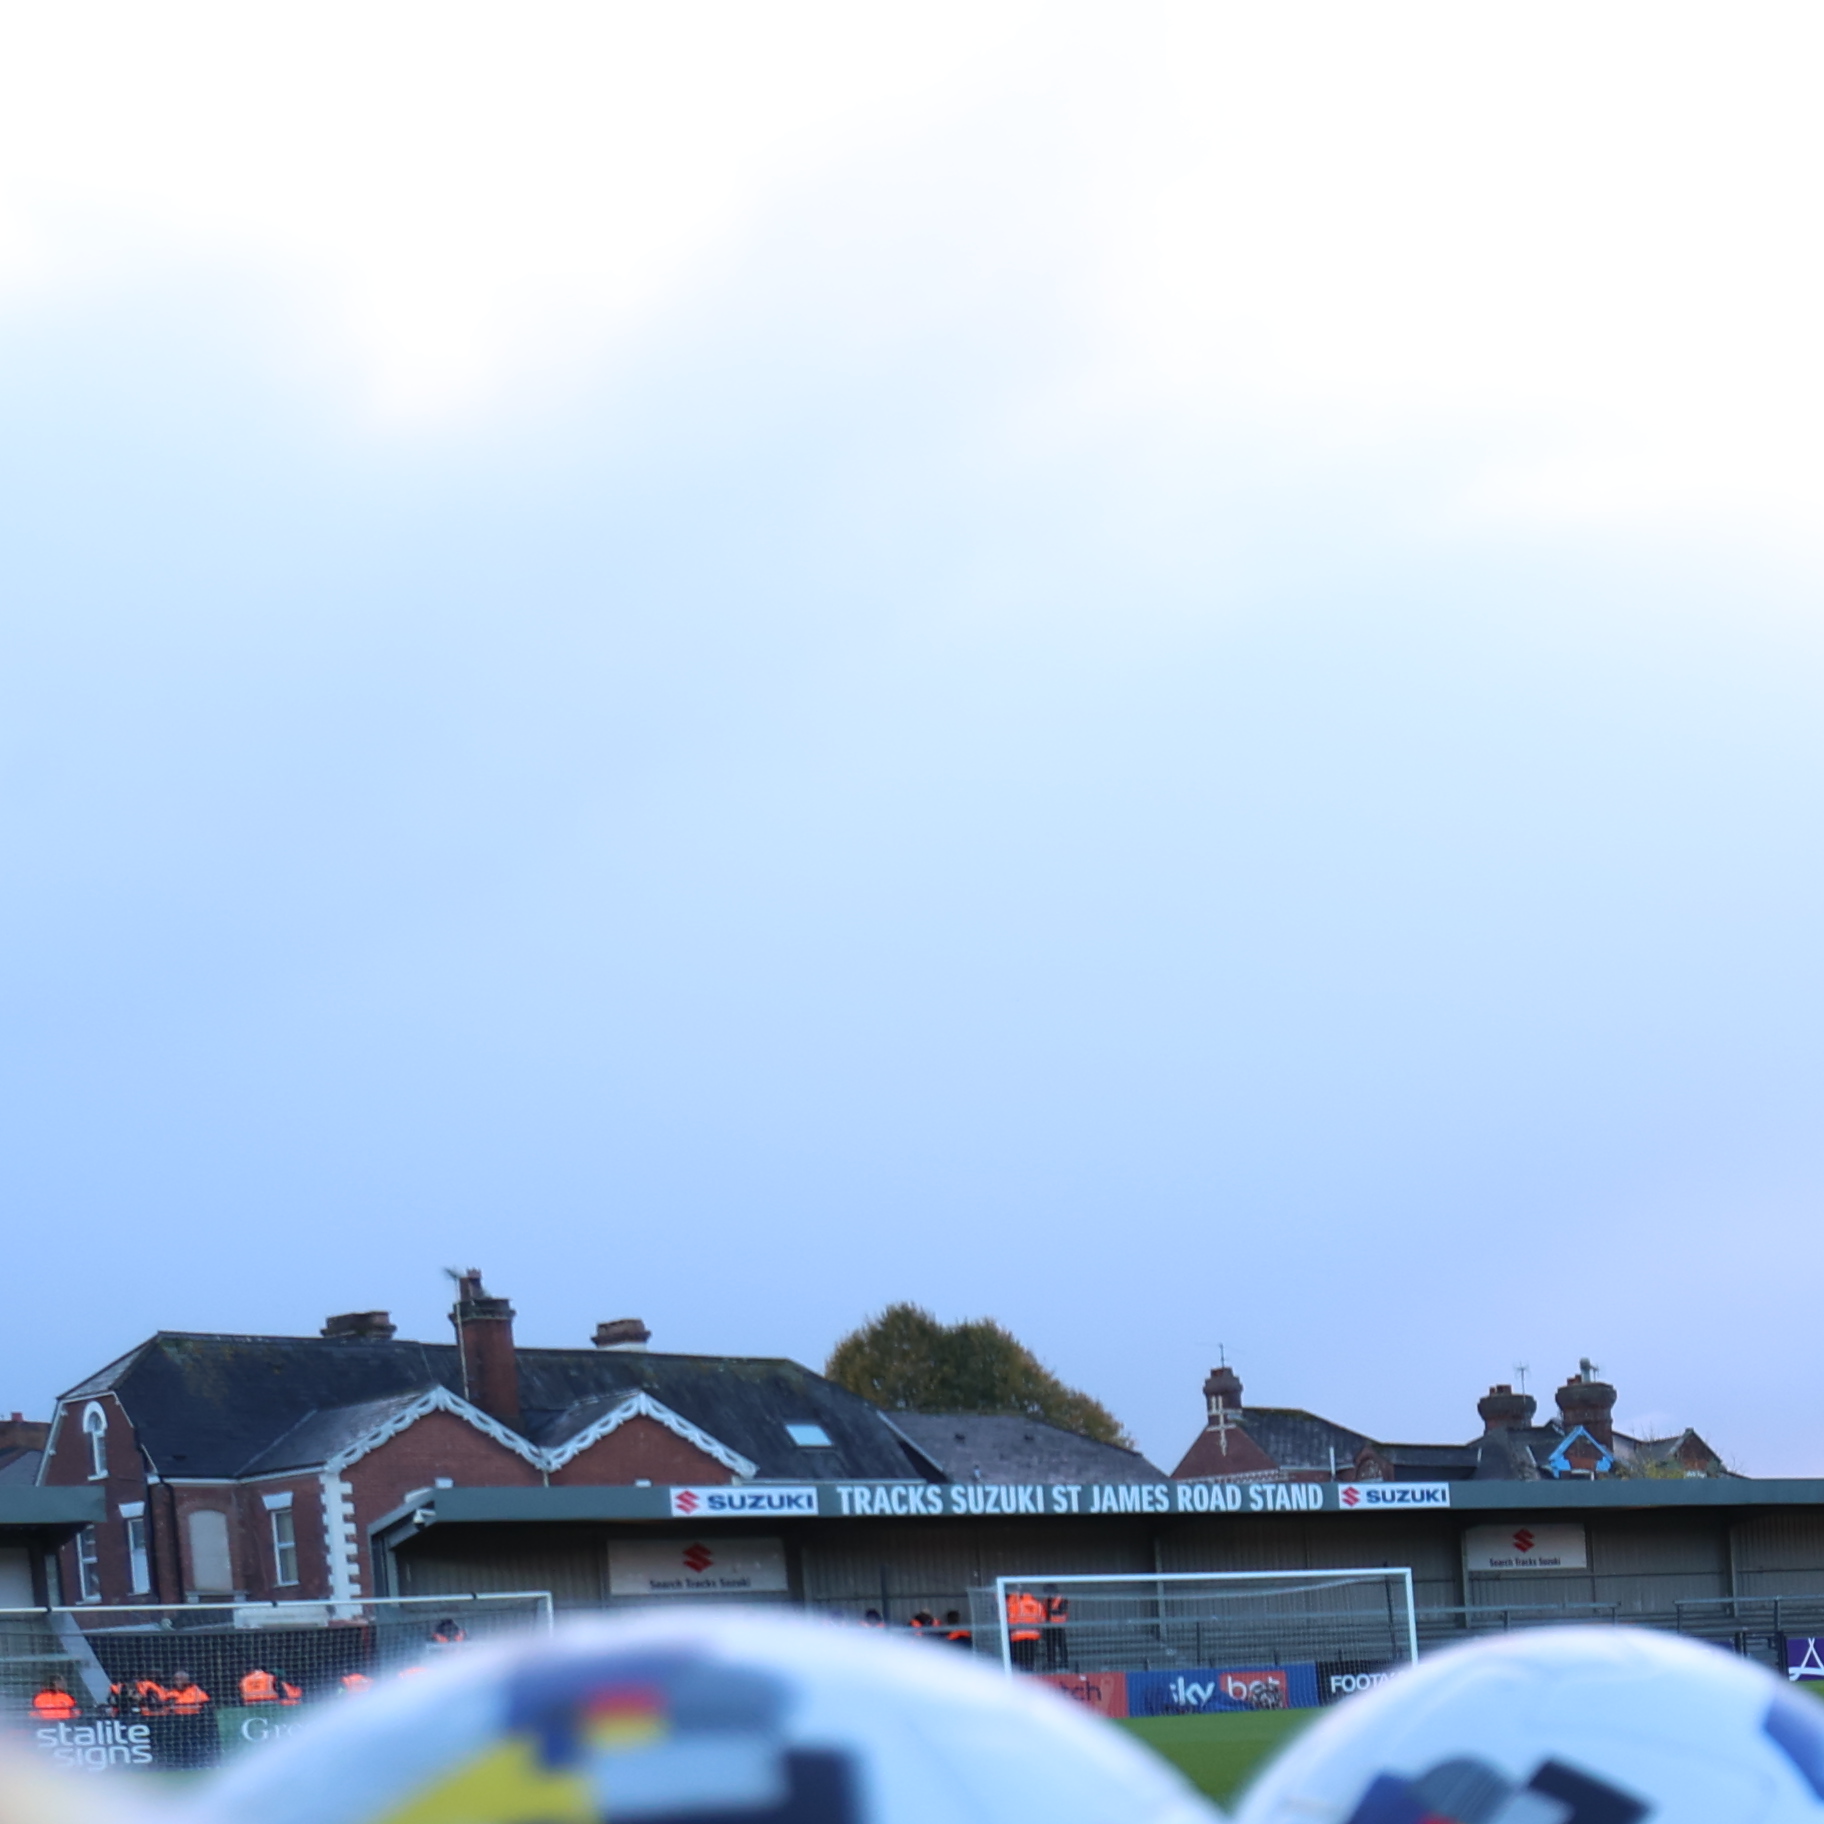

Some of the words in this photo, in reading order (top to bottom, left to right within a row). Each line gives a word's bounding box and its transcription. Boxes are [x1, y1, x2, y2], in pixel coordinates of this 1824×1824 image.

[708, 1493, 814, 1511] SUZUKI
[836, 1485, 943, 1515] TRACKS
[950, 1484, 1045, 1514] SUZUKI
[1052, 1484, 1082, 1513] ST
[1090, 1483, 1169, 1514] JAMES
[1177, 1483, 1242, 1512] ROAD
[1249, 1483, 1324, 1511] STAND
[1366, 1487, 1447, 1504] SUZUKI
[1515, 1557, 1537, 1566] Tracks
[1539, 1557, 1561, 1566] Suzuki
[650, 1577, 682, 1589] Search
[685, 1577, 717, 1588] Tracks
[36, 1720, 151, 1748] stalite
[52, 1745, 153, 1771] signs
